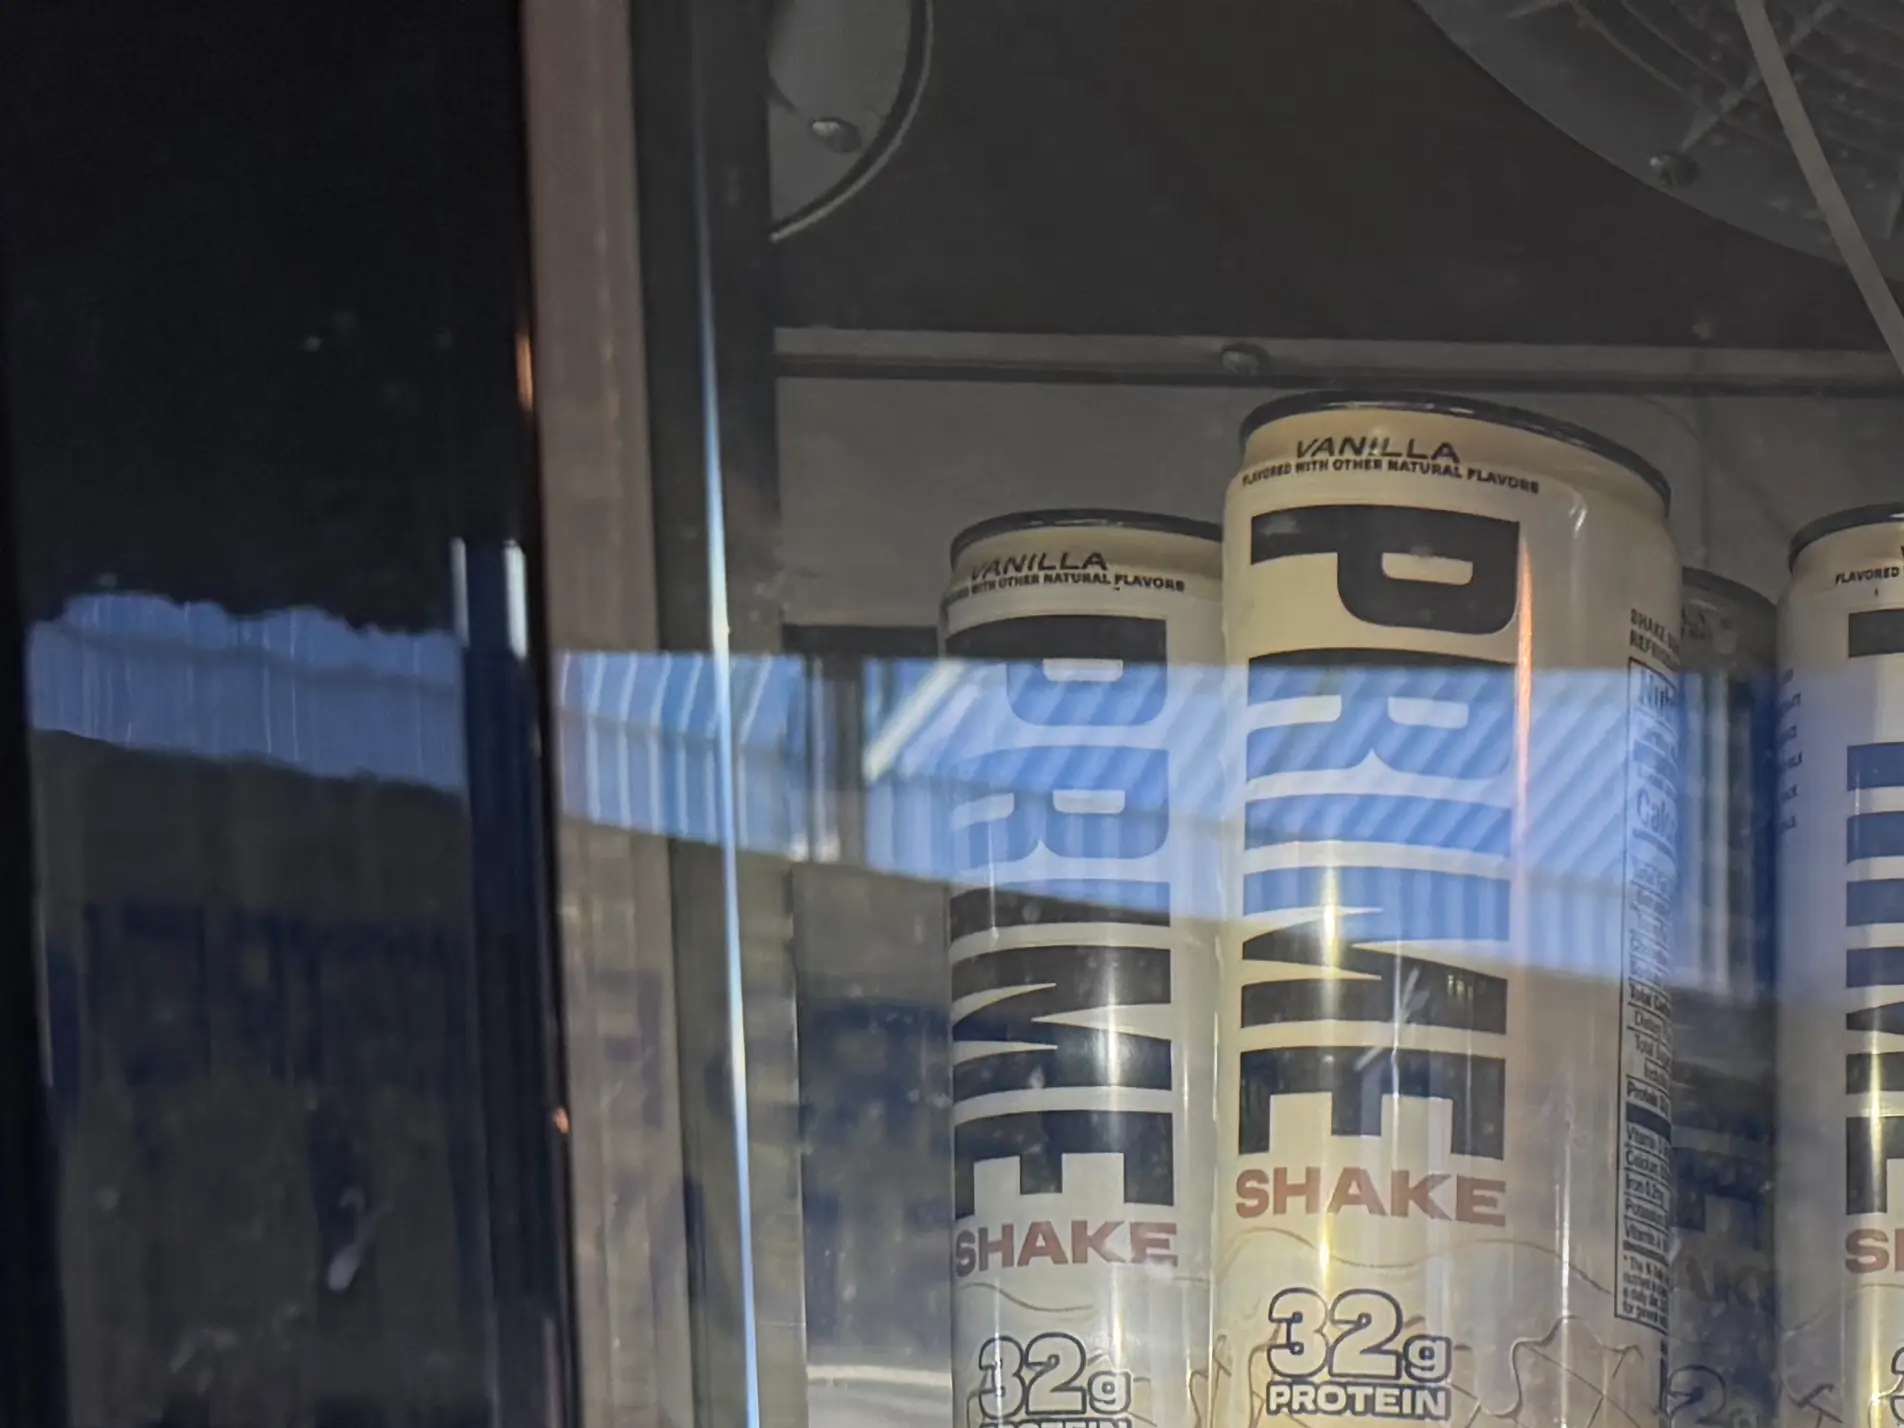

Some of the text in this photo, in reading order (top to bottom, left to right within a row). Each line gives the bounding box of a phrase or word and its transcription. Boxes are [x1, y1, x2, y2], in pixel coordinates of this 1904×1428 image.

[1242, 458, 1540, 494] FLAVORED WITH OTHER NATURAL FLAVORS
[1296, 437, 1462, 465] VANILLA
[1239, 503, 1521, 1158] PRIME
[1236, 1166, 1506, 1227] SHAKE
[1267, 1288, 1452, 1382] 32g
[1266, 1381, 1452, 1420] PROTEIN
